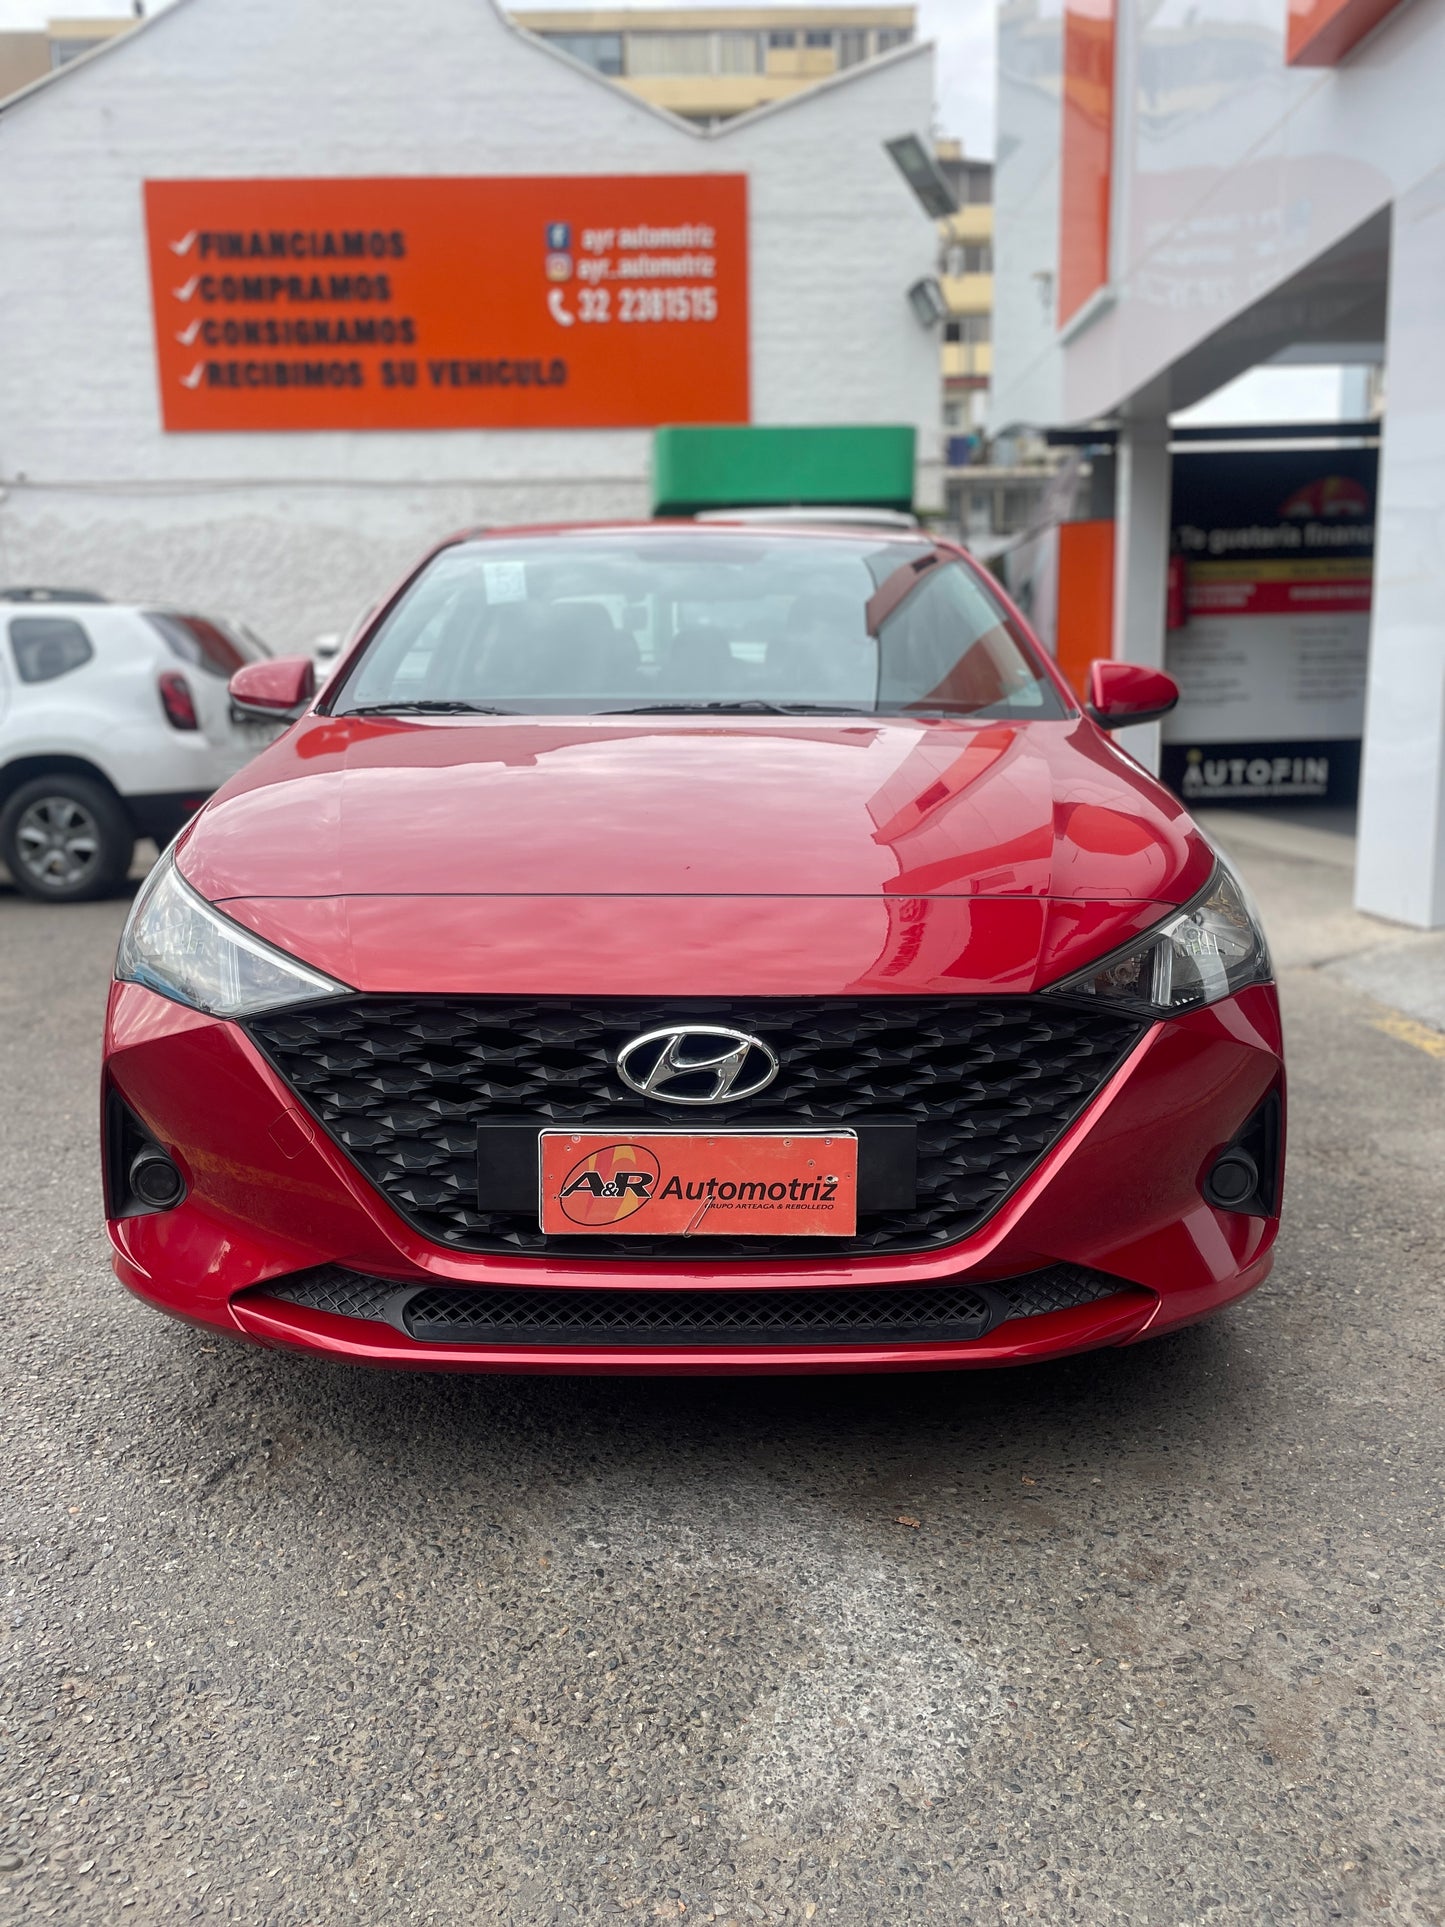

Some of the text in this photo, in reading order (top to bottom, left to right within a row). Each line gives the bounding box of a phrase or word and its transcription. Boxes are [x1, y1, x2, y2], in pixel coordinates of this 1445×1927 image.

[200, 231, 405, 258] FINANCIAMOS
[617, 224, 716, 249] automotriz
[200, 274, 391, 301] COMPRAMOS
[577, 287, 612, 323] 32
[202, 318, 416, 346] CONSIGNAMOS
[206, 357, 568, 388] RECIBIMOS SU VEHICULO
[1183, 755, 1329, 787] AUTOFIN
[559, 1170, 838, 1202] A&R Automotriz
[785, 1203, 834, 1211] REBOLLEDO
